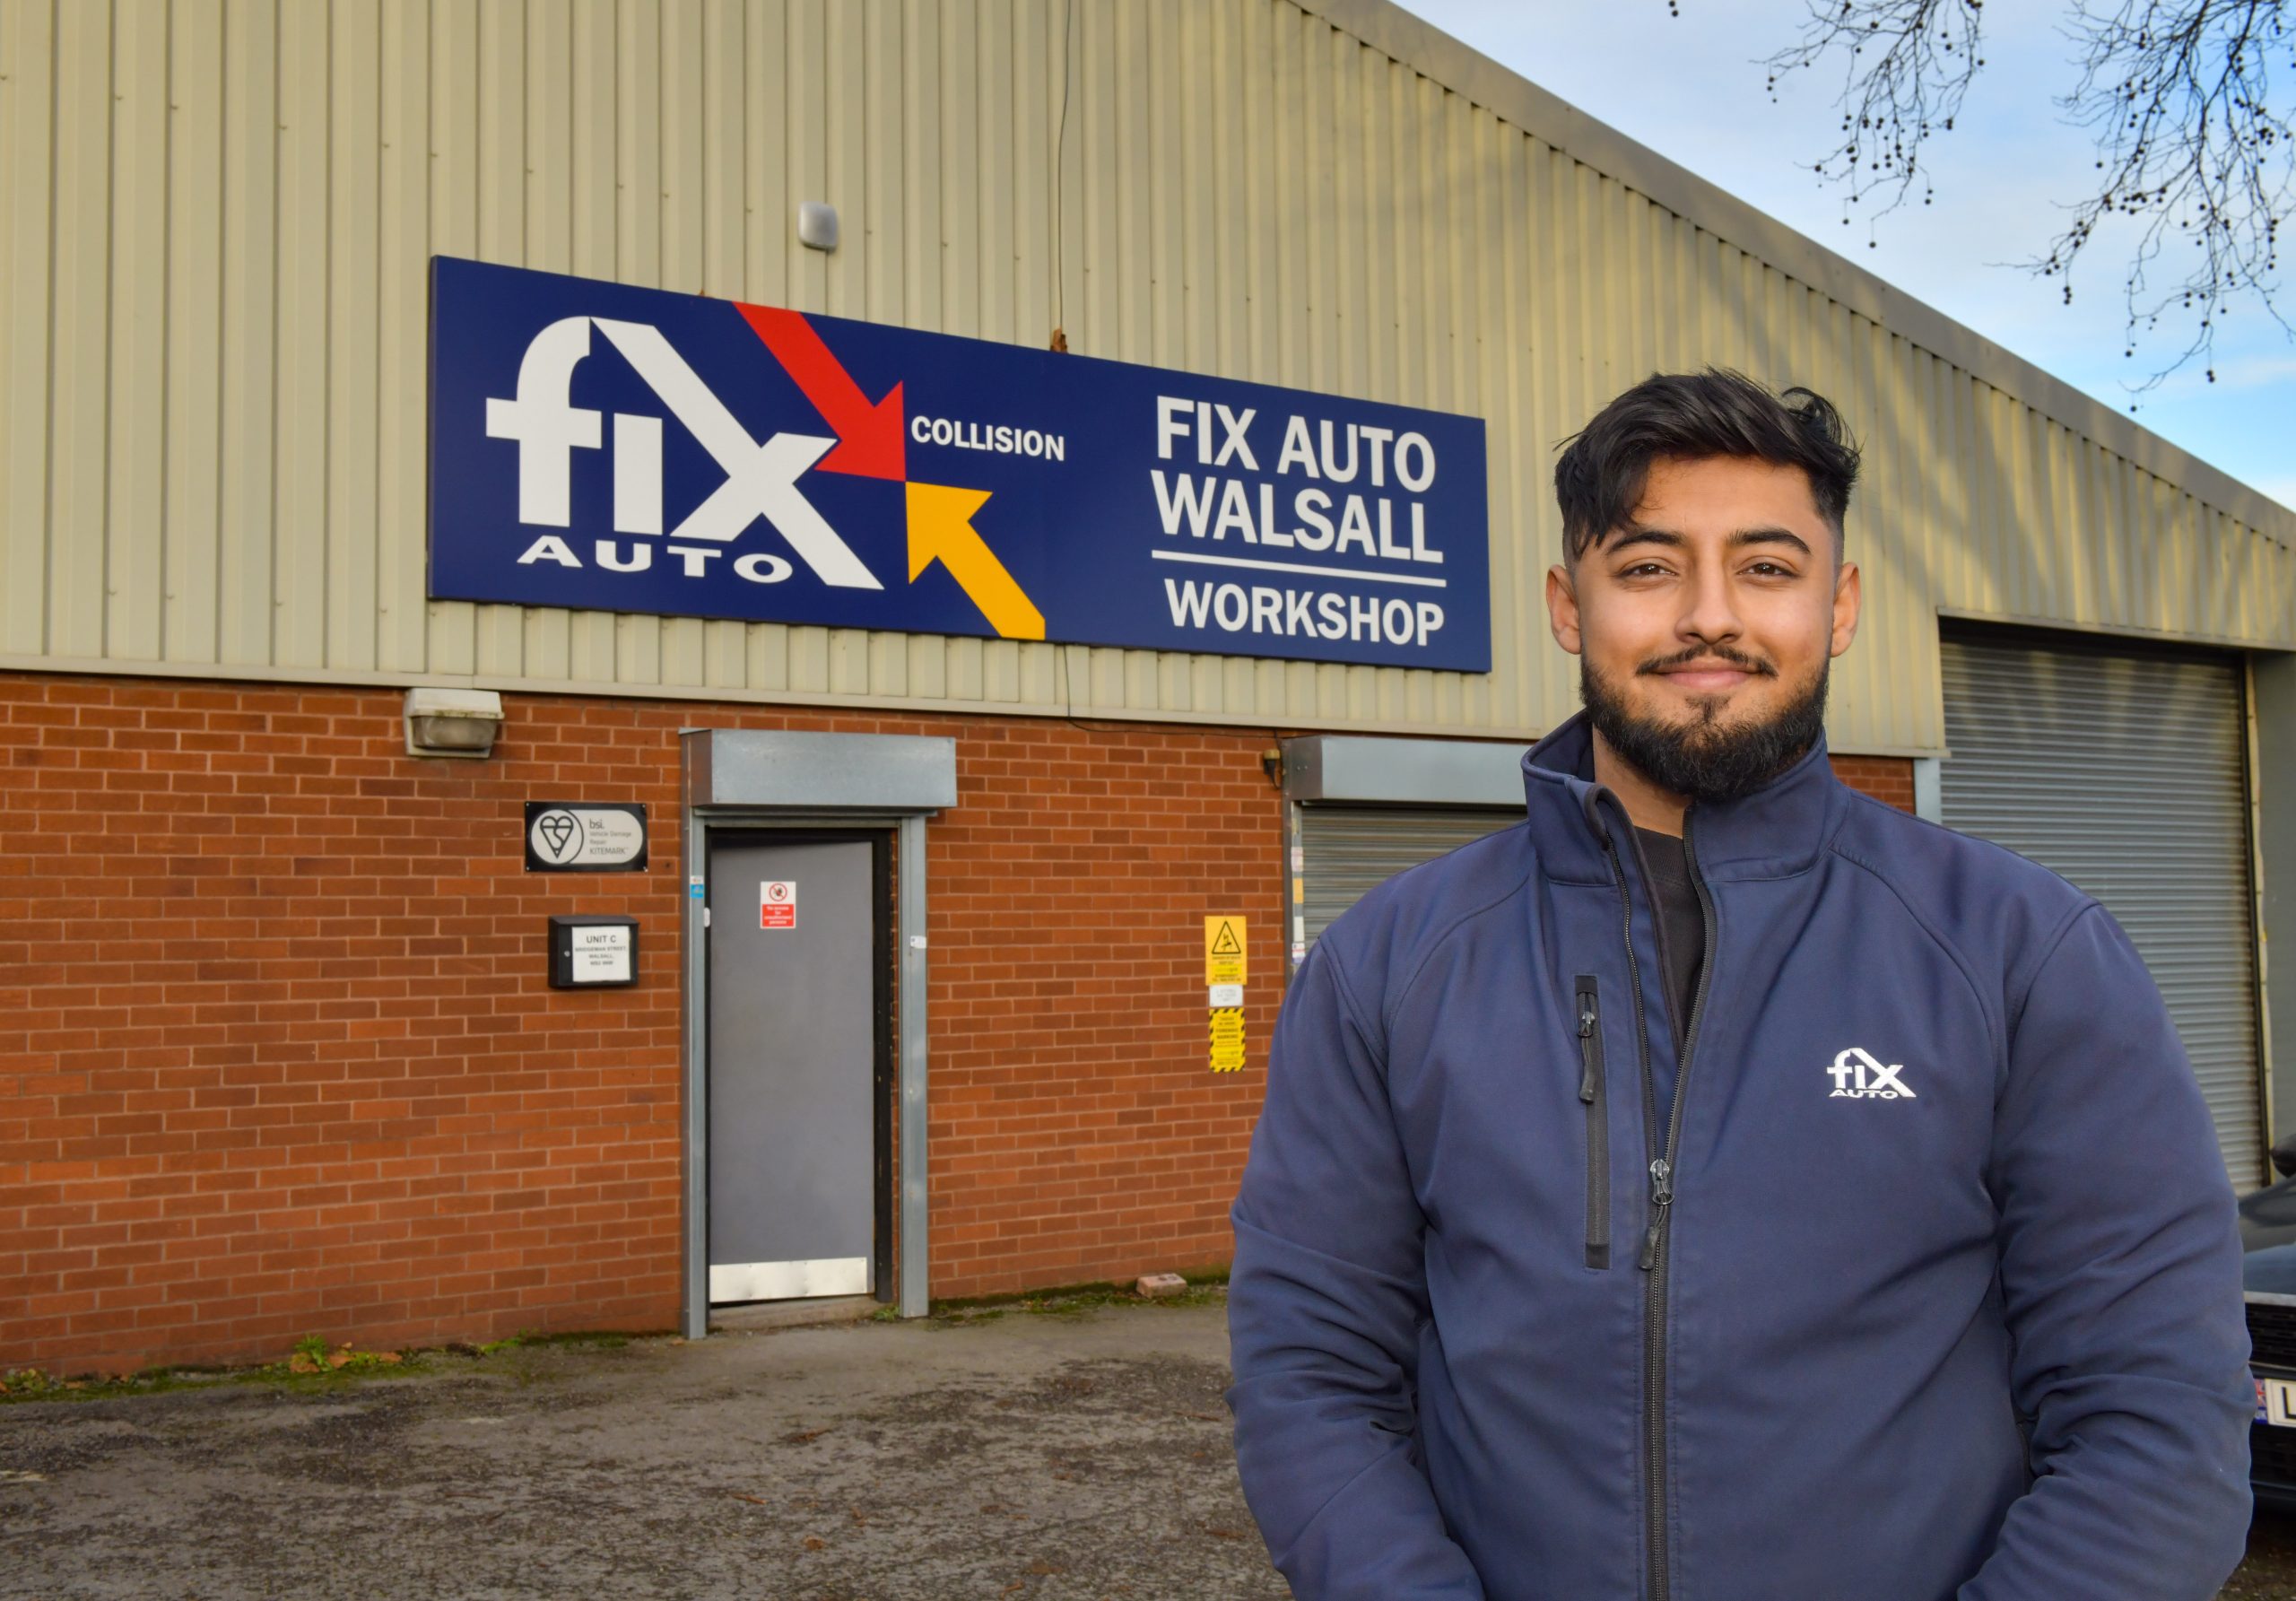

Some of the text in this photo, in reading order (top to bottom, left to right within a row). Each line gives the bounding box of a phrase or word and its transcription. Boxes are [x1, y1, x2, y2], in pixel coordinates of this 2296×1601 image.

[911, 415, 1065, 461] COLLISION
[1157, 396, 1436, 492] FIX AUTO
[1151, 469, 1444, 564] WALSALL
[517, 535, 793, 584] AUTO
[1164, 578, 1445, 647] WORKSHOP
[586, 935, 617, 944] UNIT C
[1829, 1088, 1899, 1099] AUTO
